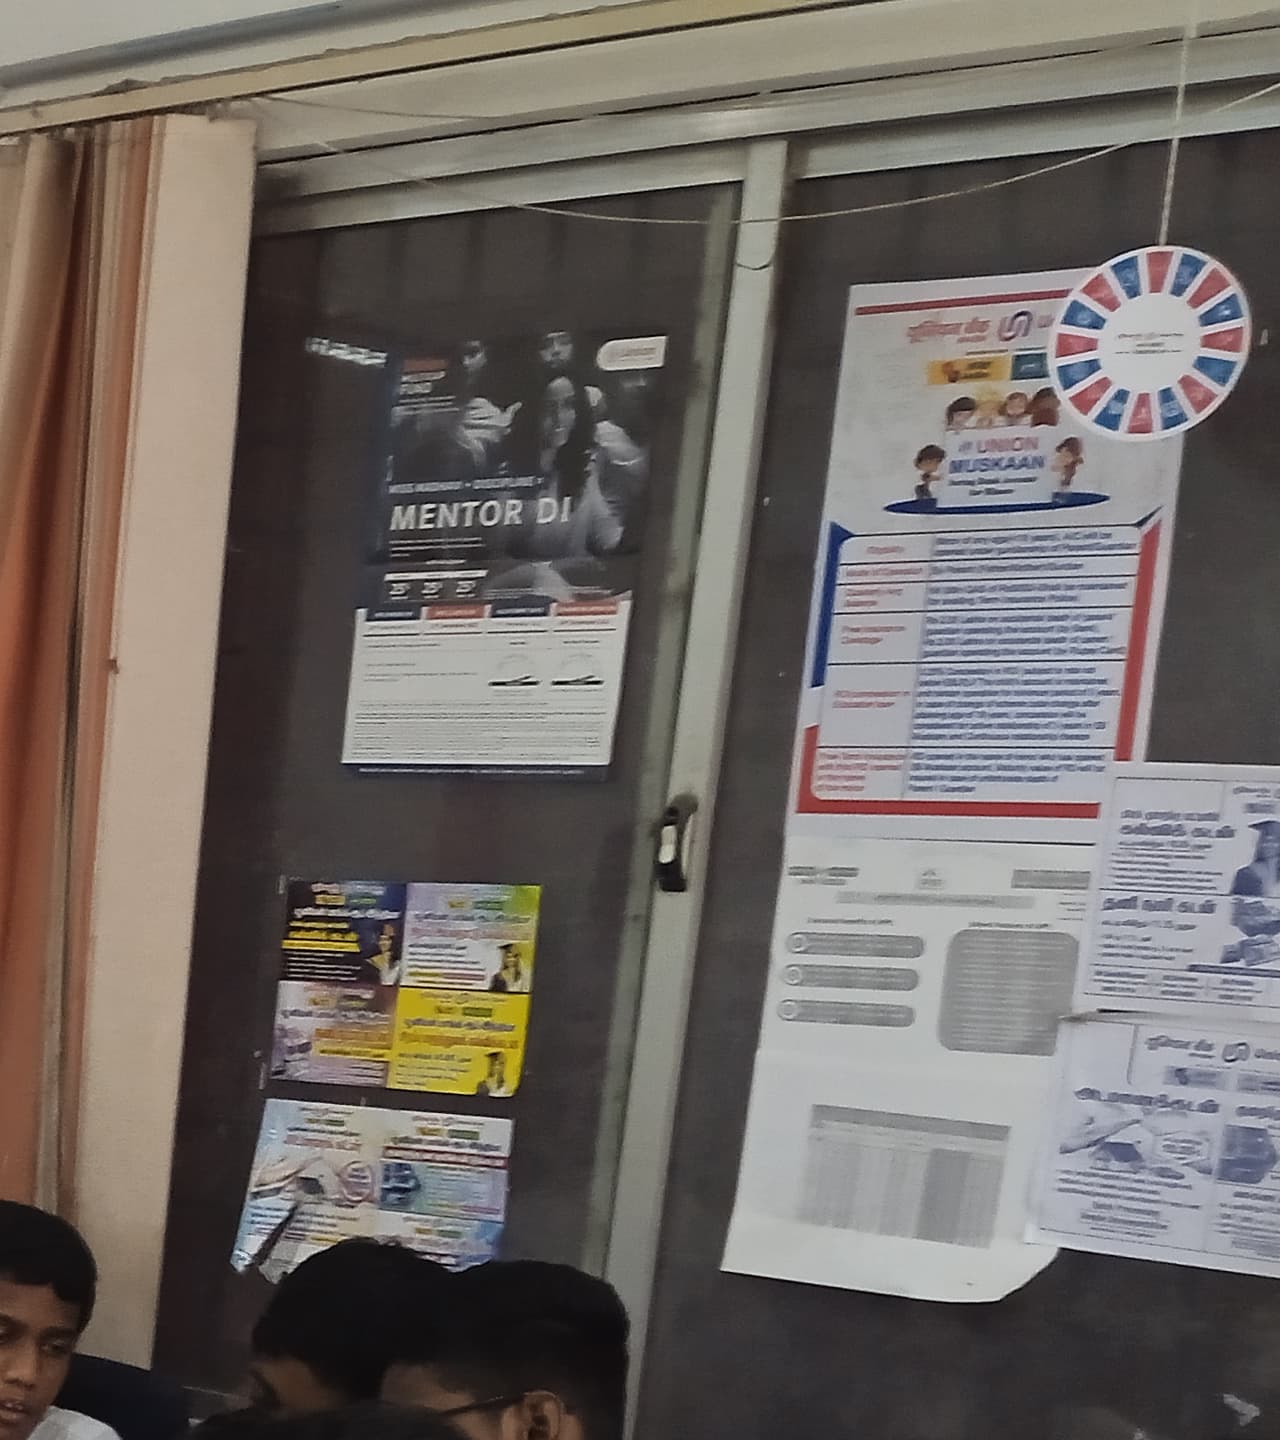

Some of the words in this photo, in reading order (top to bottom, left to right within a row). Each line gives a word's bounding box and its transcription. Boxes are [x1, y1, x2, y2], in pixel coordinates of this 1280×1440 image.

[976, 436, 1039, 453] UNION
[948, 455, 1045, 474] MUSKAAN
[389, 499, 523, 532] MENTOR
[535, 496, 572, 525] DI
